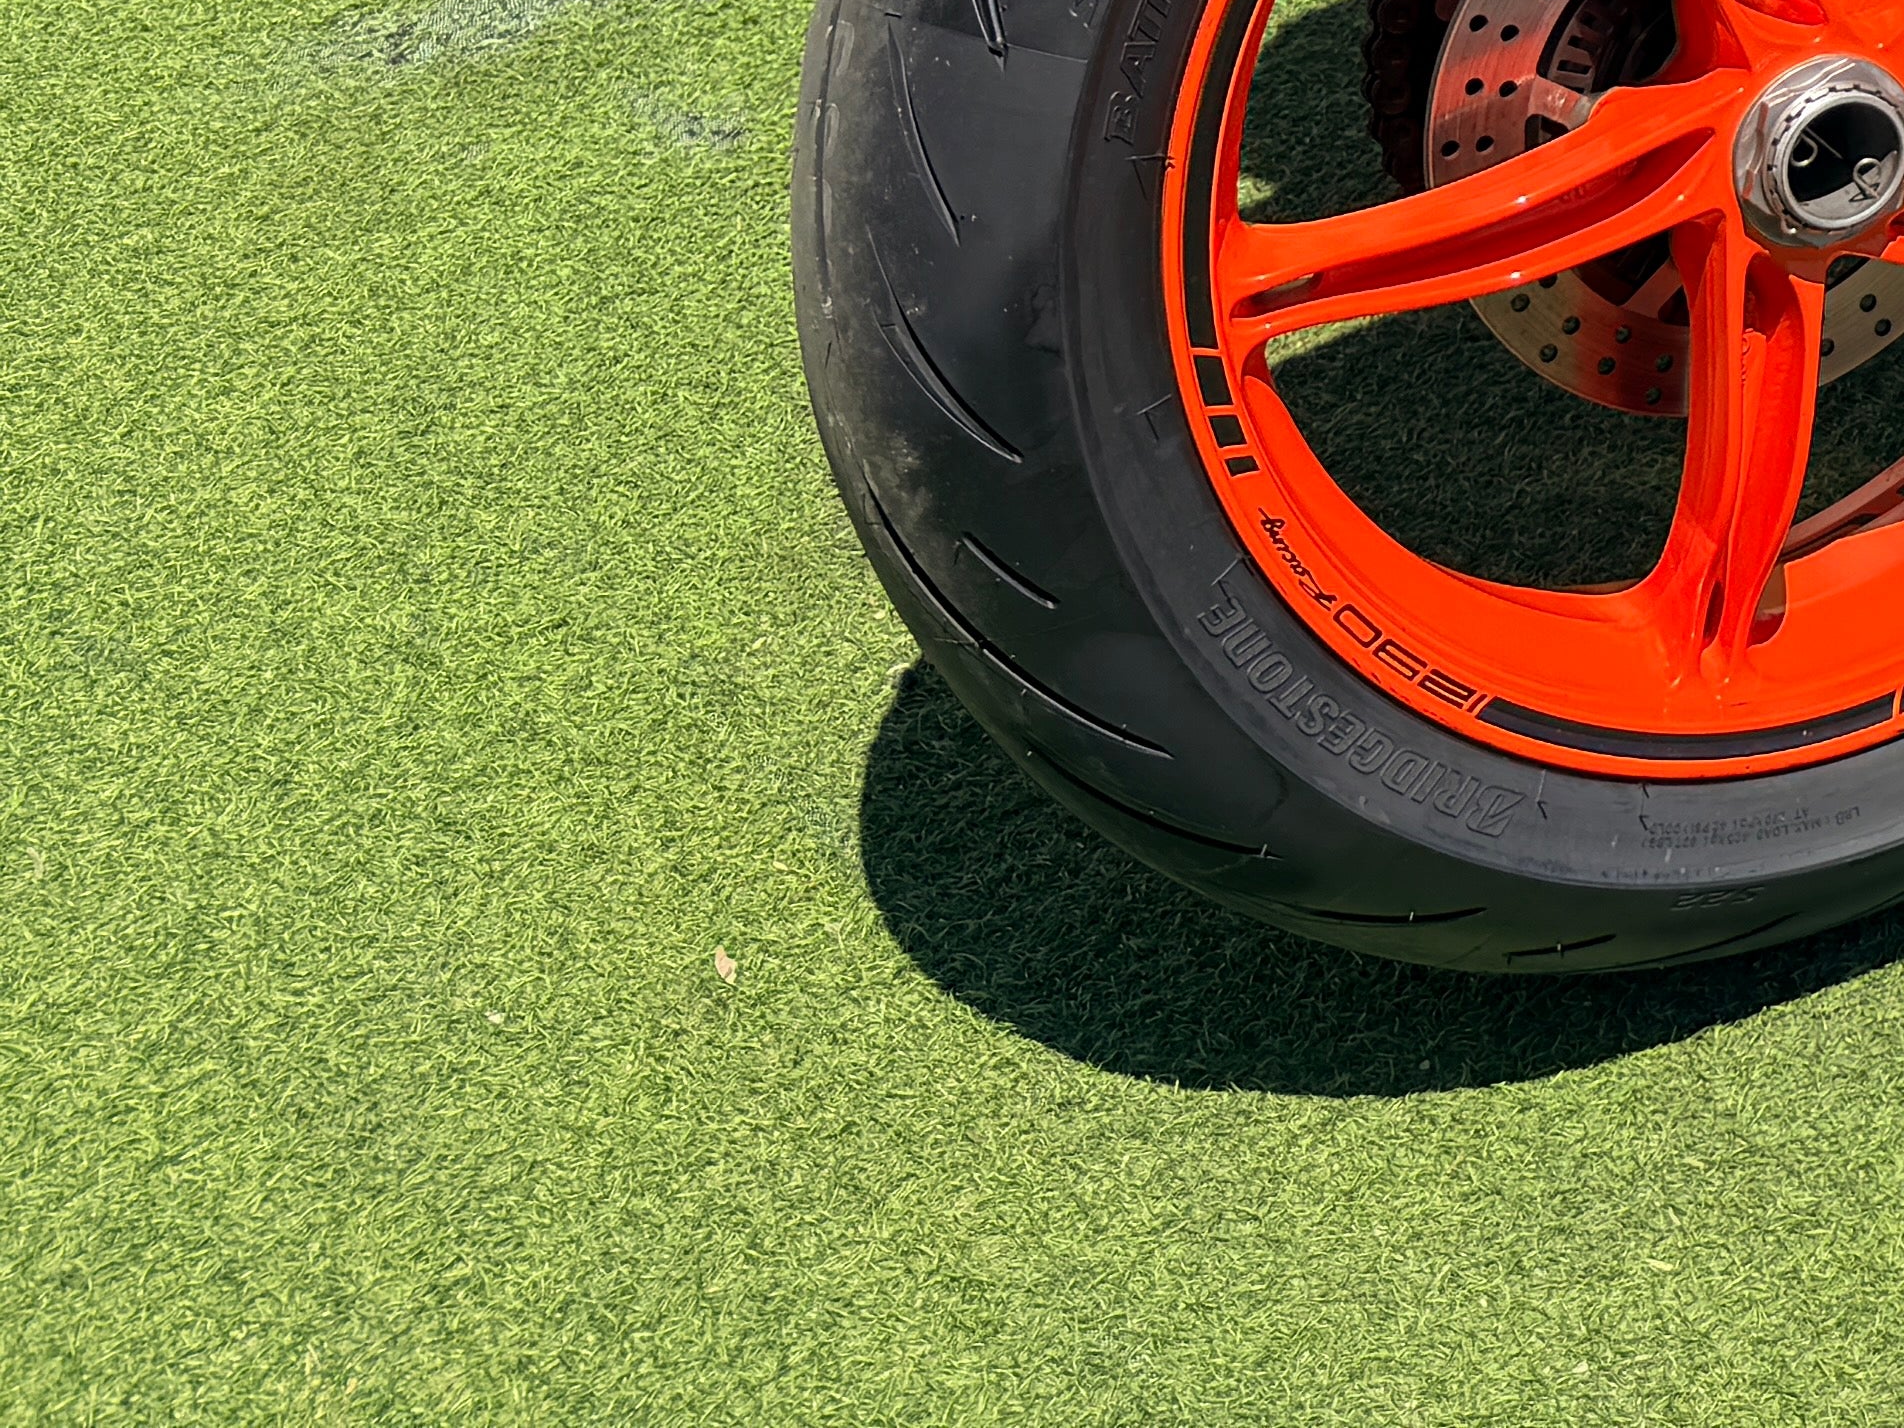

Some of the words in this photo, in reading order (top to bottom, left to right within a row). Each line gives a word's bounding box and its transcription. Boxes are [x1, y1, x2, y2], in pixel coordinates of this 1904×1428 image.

[1258, 506, 1341, 611] Racing
[1191, 584, 1523, 843] BRIDGESTONE
[1333, 603, 1486, 720] 1290
